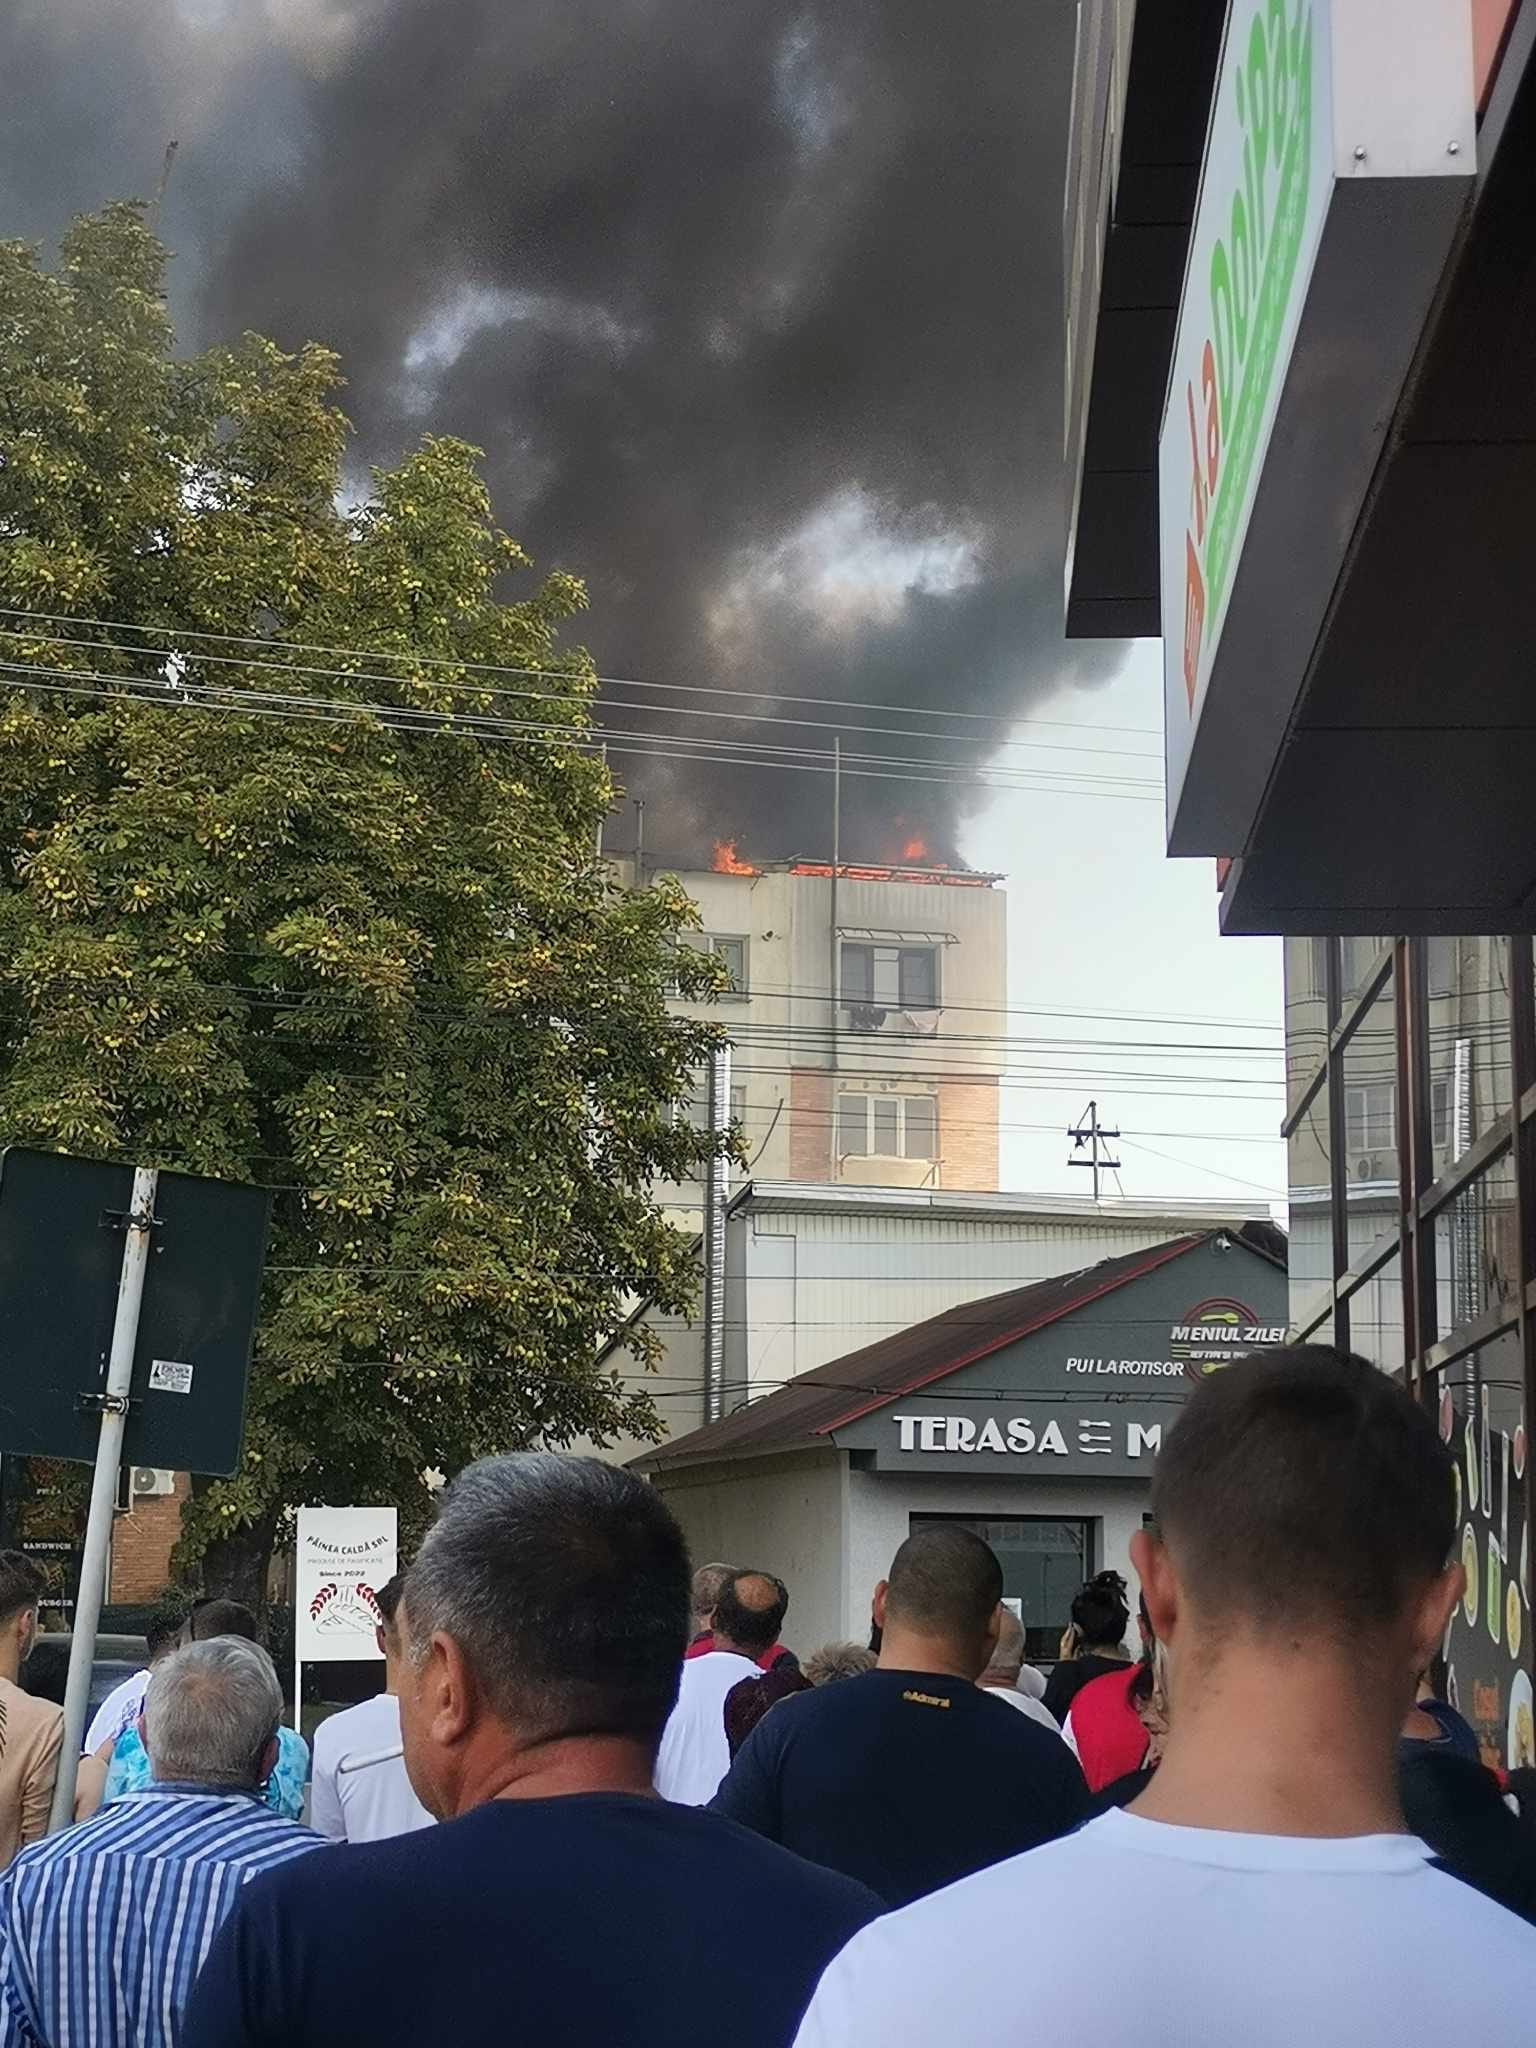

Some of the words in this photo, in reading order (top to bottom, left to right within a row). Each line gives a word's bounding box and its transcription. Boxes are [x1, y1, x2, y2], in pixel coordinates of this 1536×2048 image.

[1170, 1325, 1241, 1342] MENIUL
[1242, 1327, 1286, 1342] ZILEI
[1066, 1357, 1095, 1373] PUI
[1096, 1358, 1118, 1374] LA
[1118, 1360, 1185, 1377] ROTISOR
[892, 1415, 1069, 1455] TERASA
[23, 1541, 72, 1550] SANDWICH
